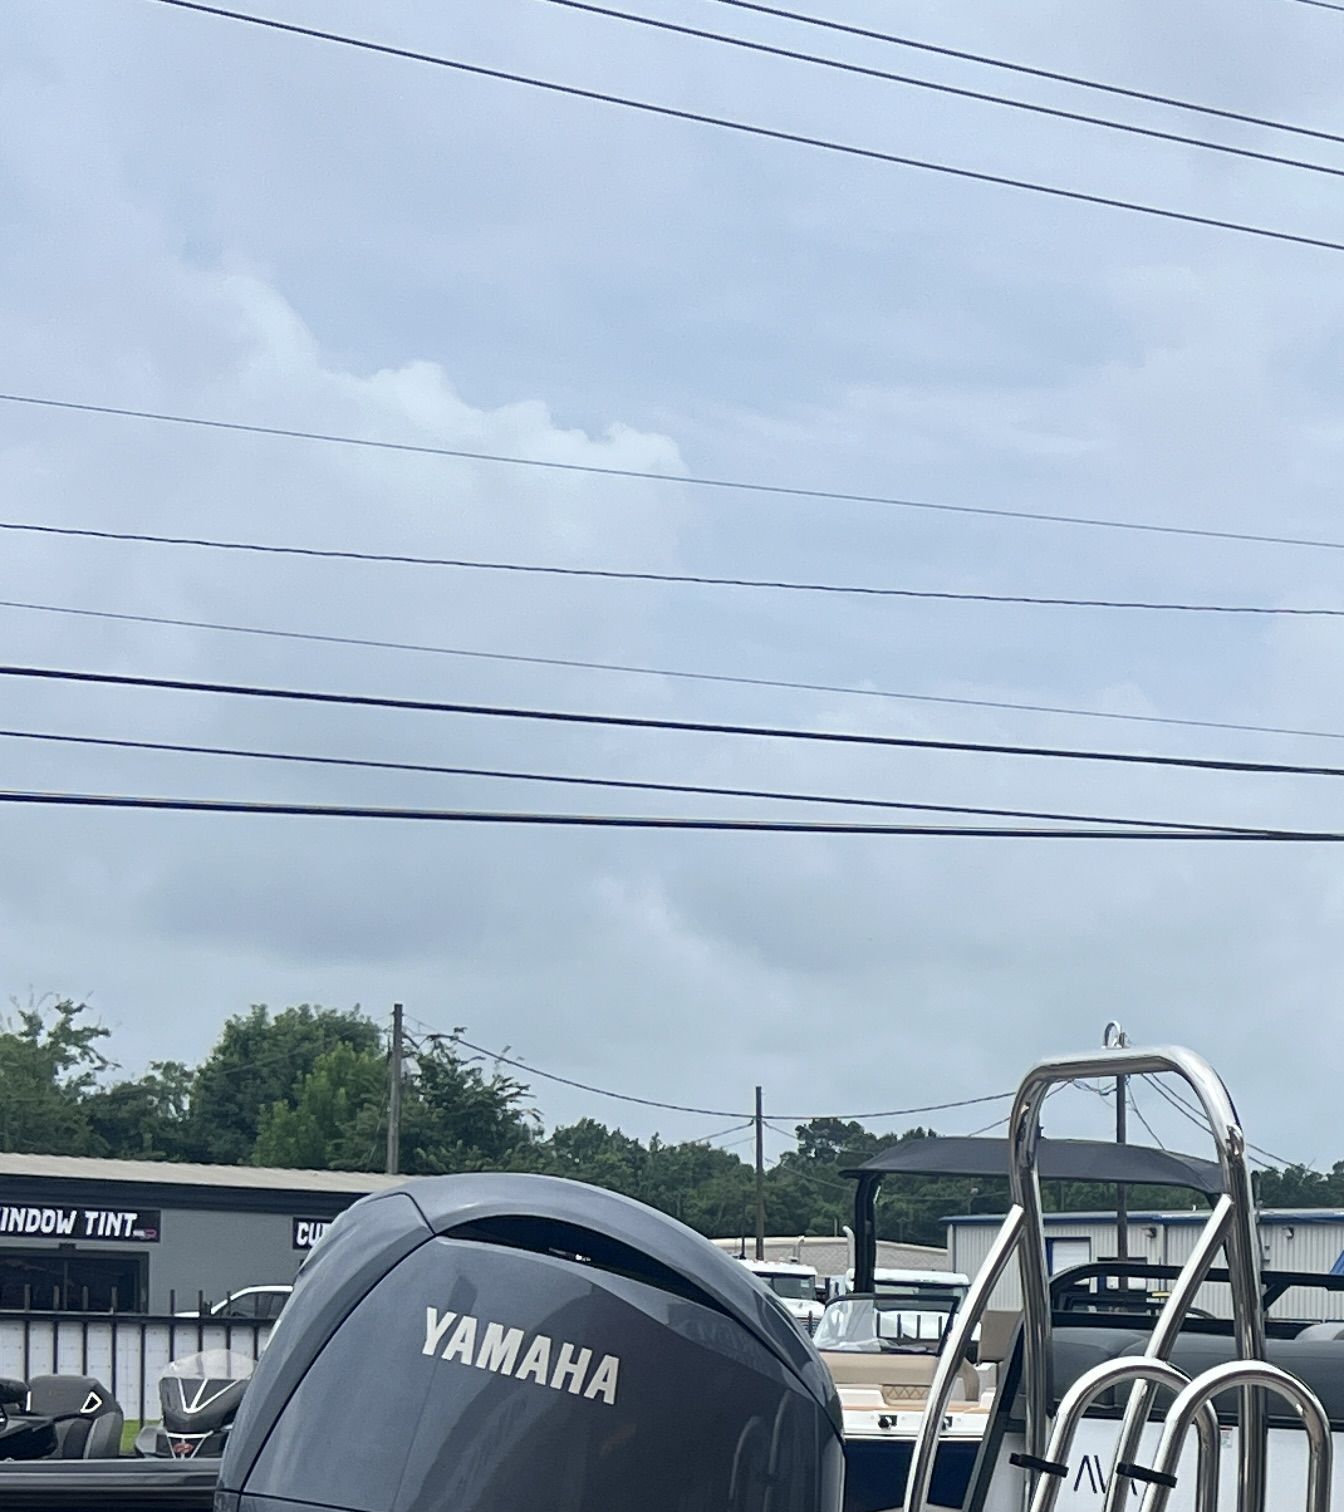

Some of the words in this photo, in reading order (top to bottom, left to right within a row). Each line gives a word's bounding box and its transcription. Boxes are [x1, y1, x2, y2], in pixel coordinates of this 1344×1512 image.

[0, 1207, 78, 1235] INDOW
[84, 1210, 138, 1238] TINT
[422, 1306, 620, 1405] YAMAHA
